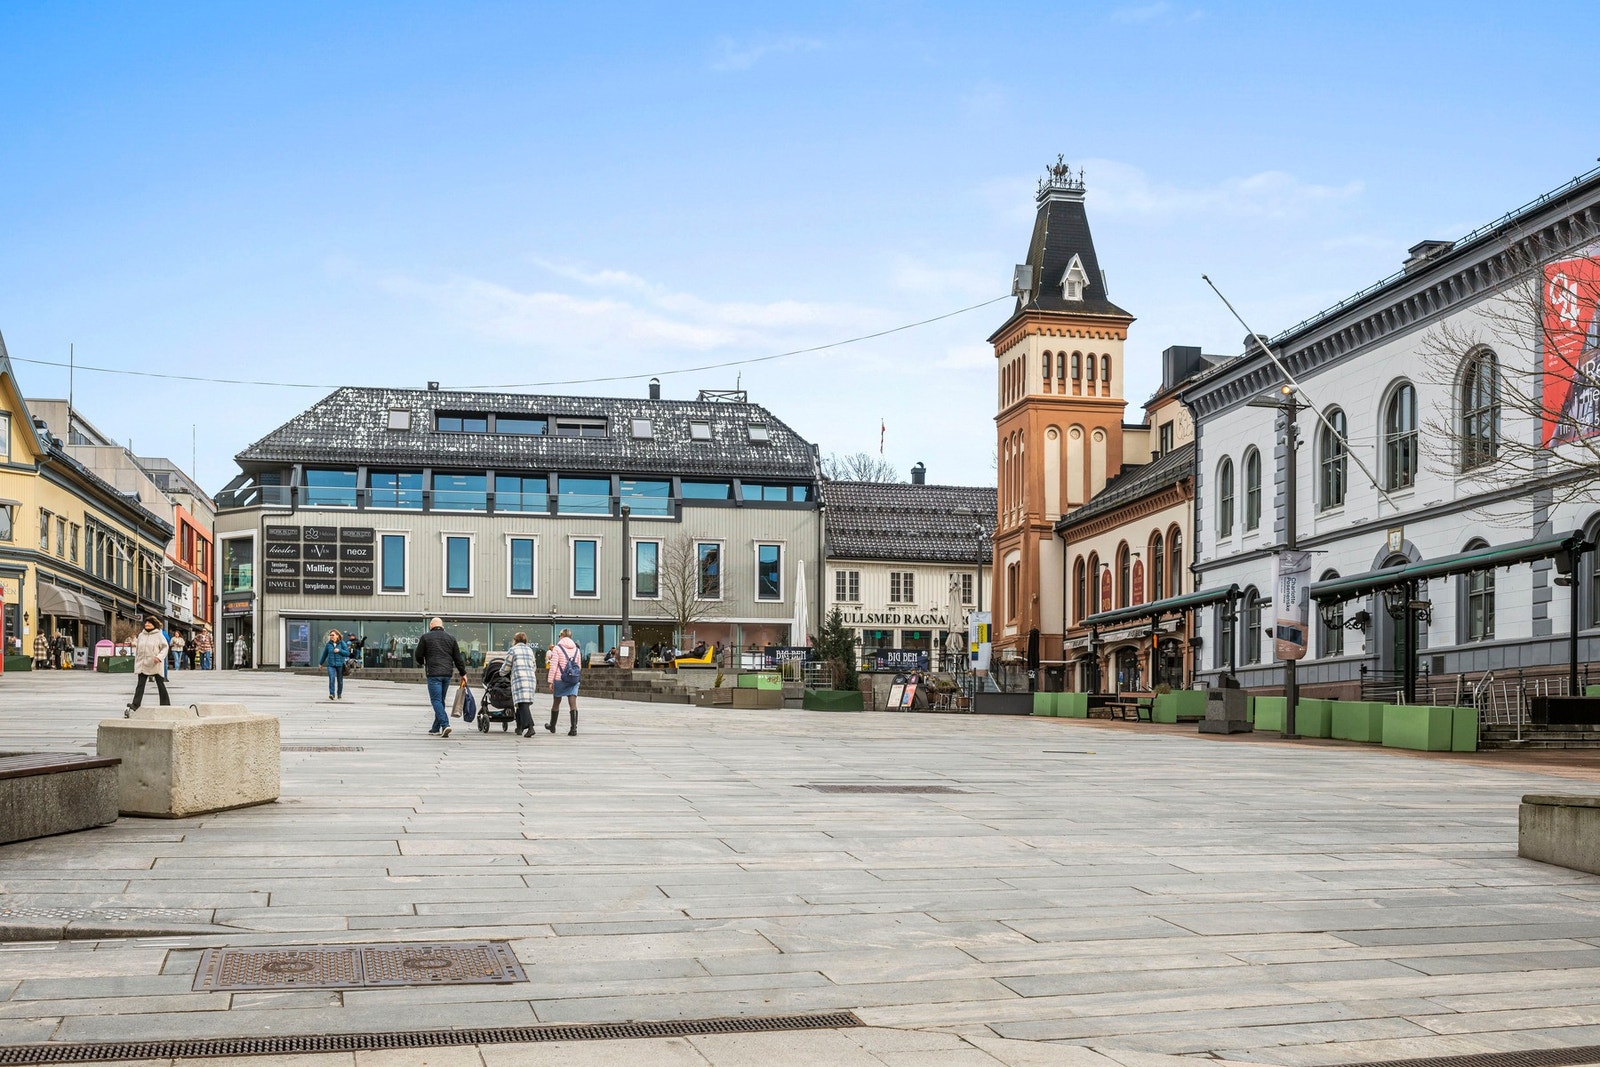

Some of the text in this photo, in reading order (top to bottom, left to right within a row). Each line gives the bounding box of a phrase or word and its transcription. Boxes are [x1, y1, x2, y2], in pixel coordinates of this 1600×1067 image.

[346, 548, 367, 556] neoz
[306, 563, 334, 574] Malling
[394, 636, 419, 645] MOND
[887, 652, 900, 662] BIG
[902, 652, 918, 662] BEN
